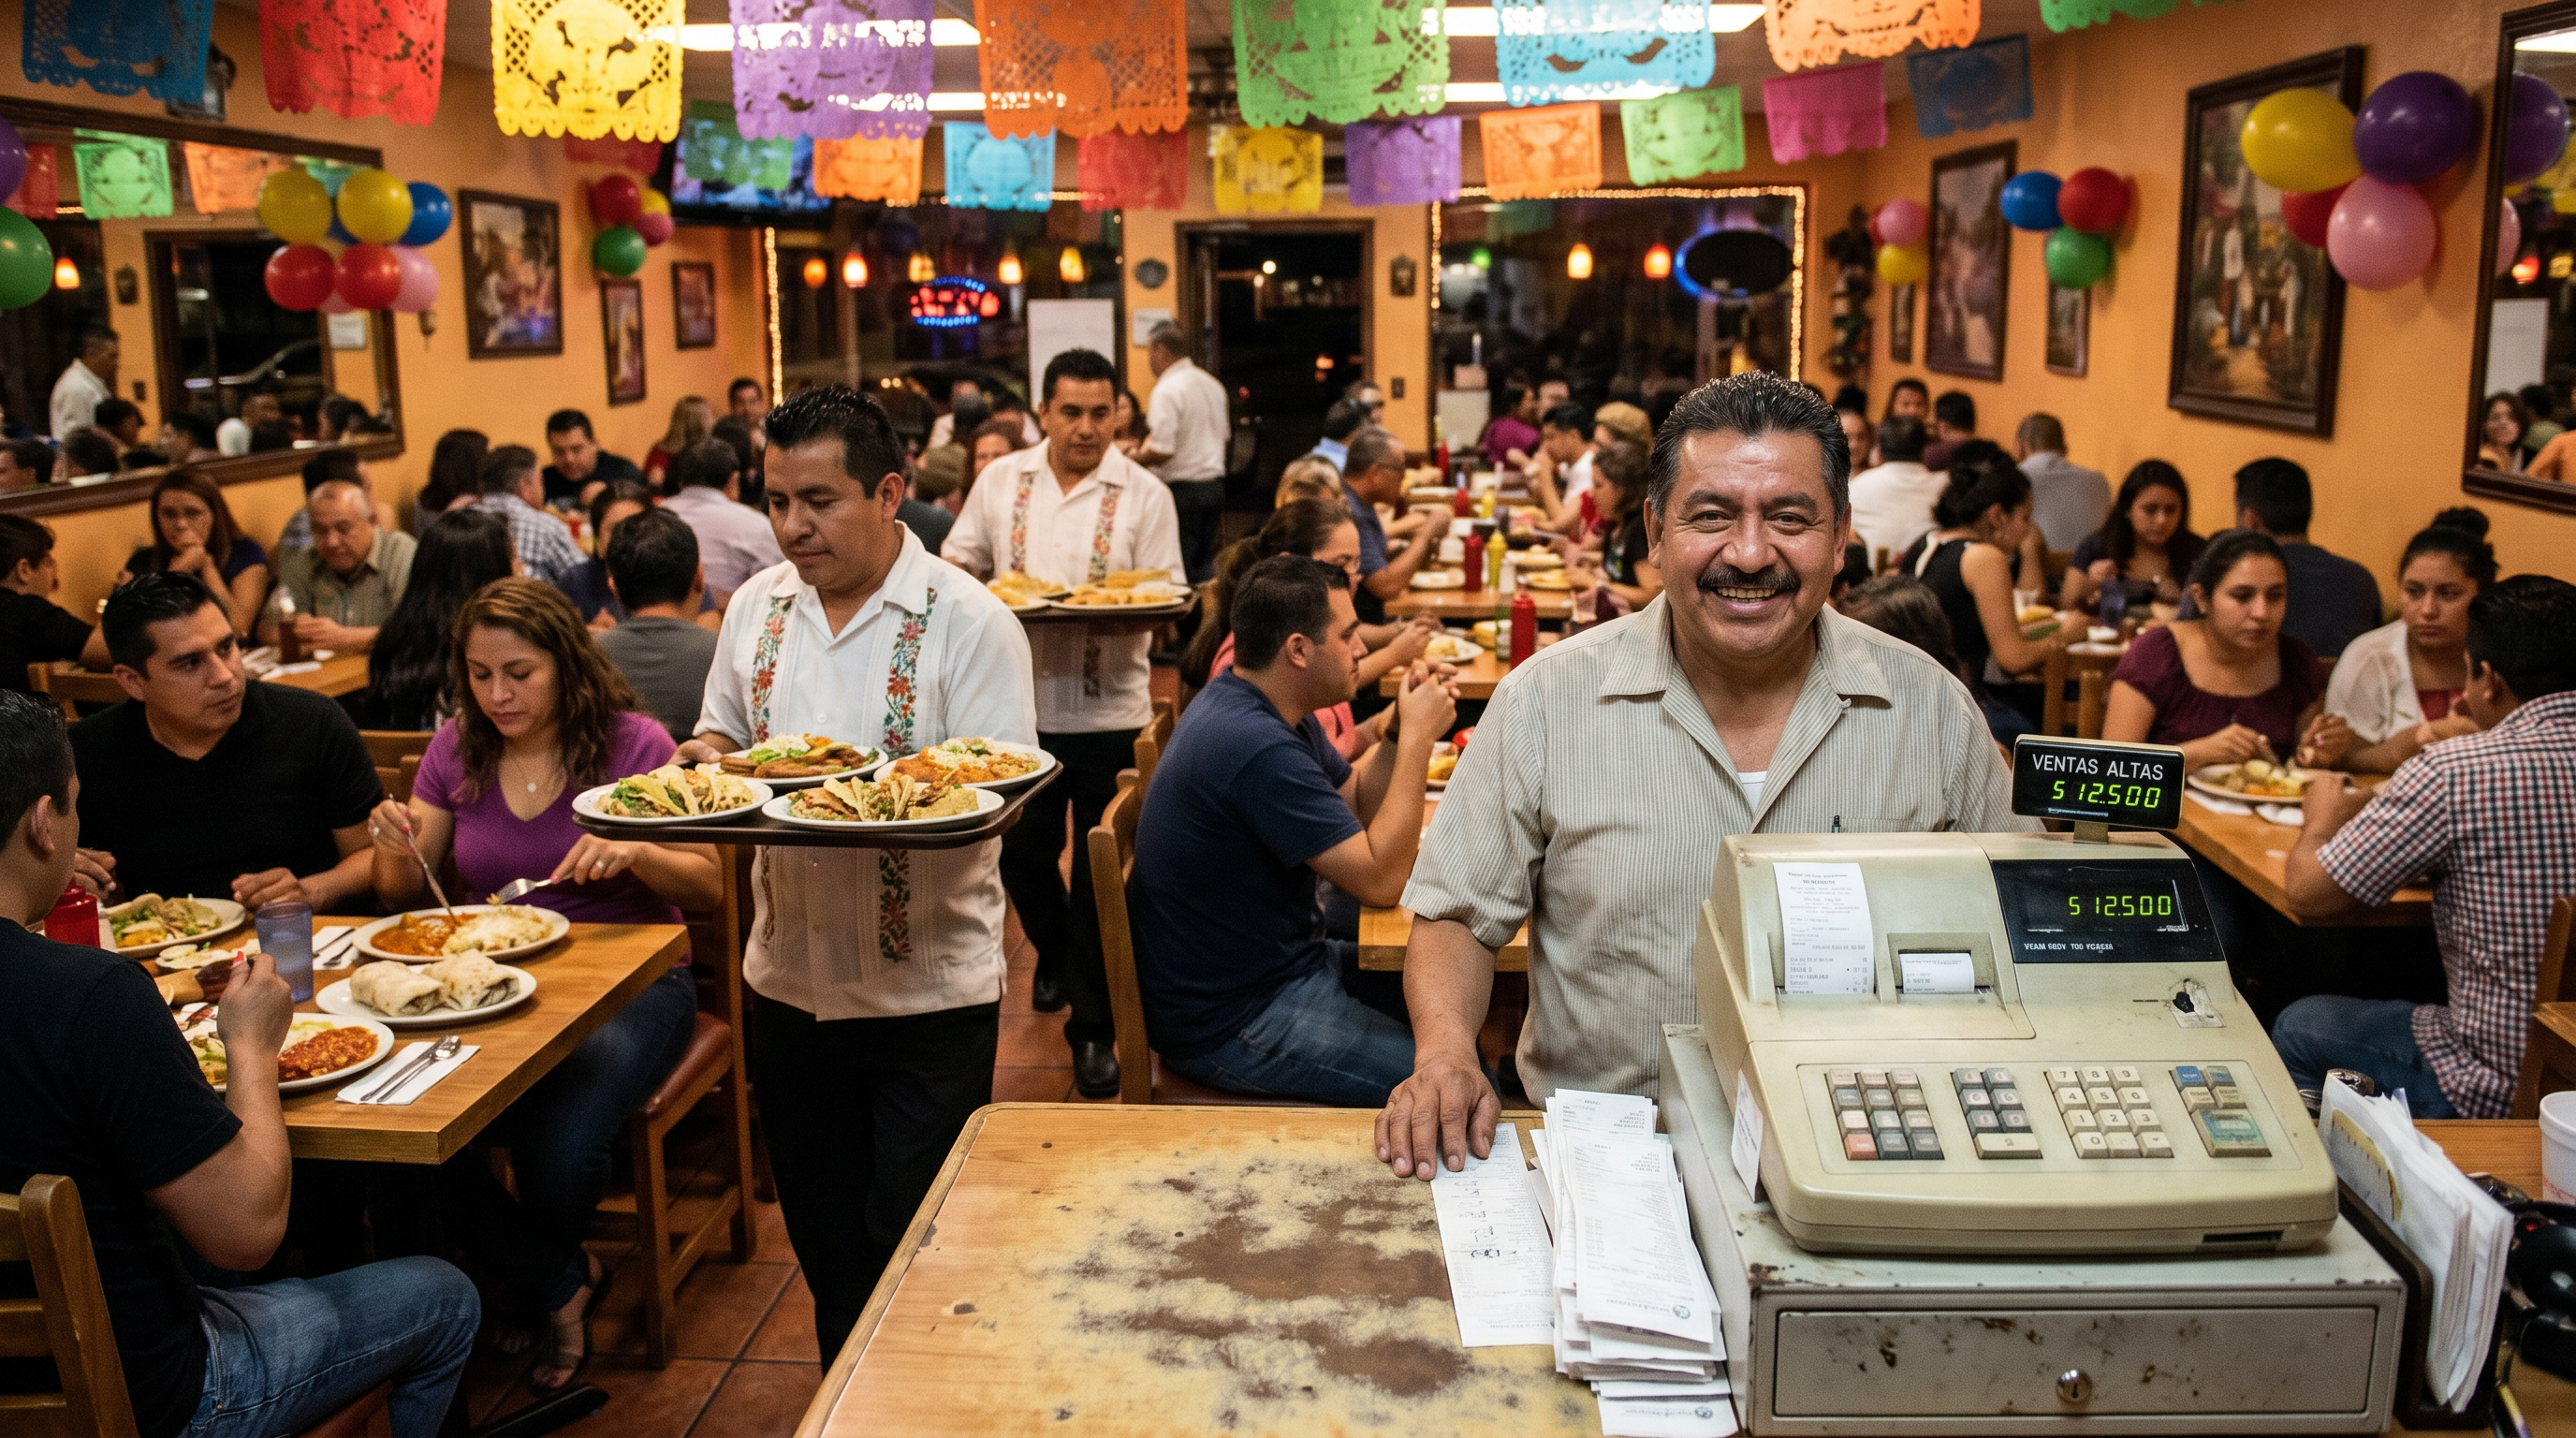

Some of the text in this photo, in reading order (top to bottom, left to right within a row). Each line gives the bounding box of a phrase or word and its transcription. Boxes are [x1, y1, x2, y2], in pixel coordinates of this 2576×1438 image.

[2032, 754, 2164, 781] VENTAS ALTAS
[2059, 1070, 2068, 1078] 7
[2091, 1070, 2100, 1078] 8
[2100, 1092, 2110, 1100] 5
[2130, 1092, 2141, 1100] 6
[2079, 1113, 2151, 1123] 1 2 3
